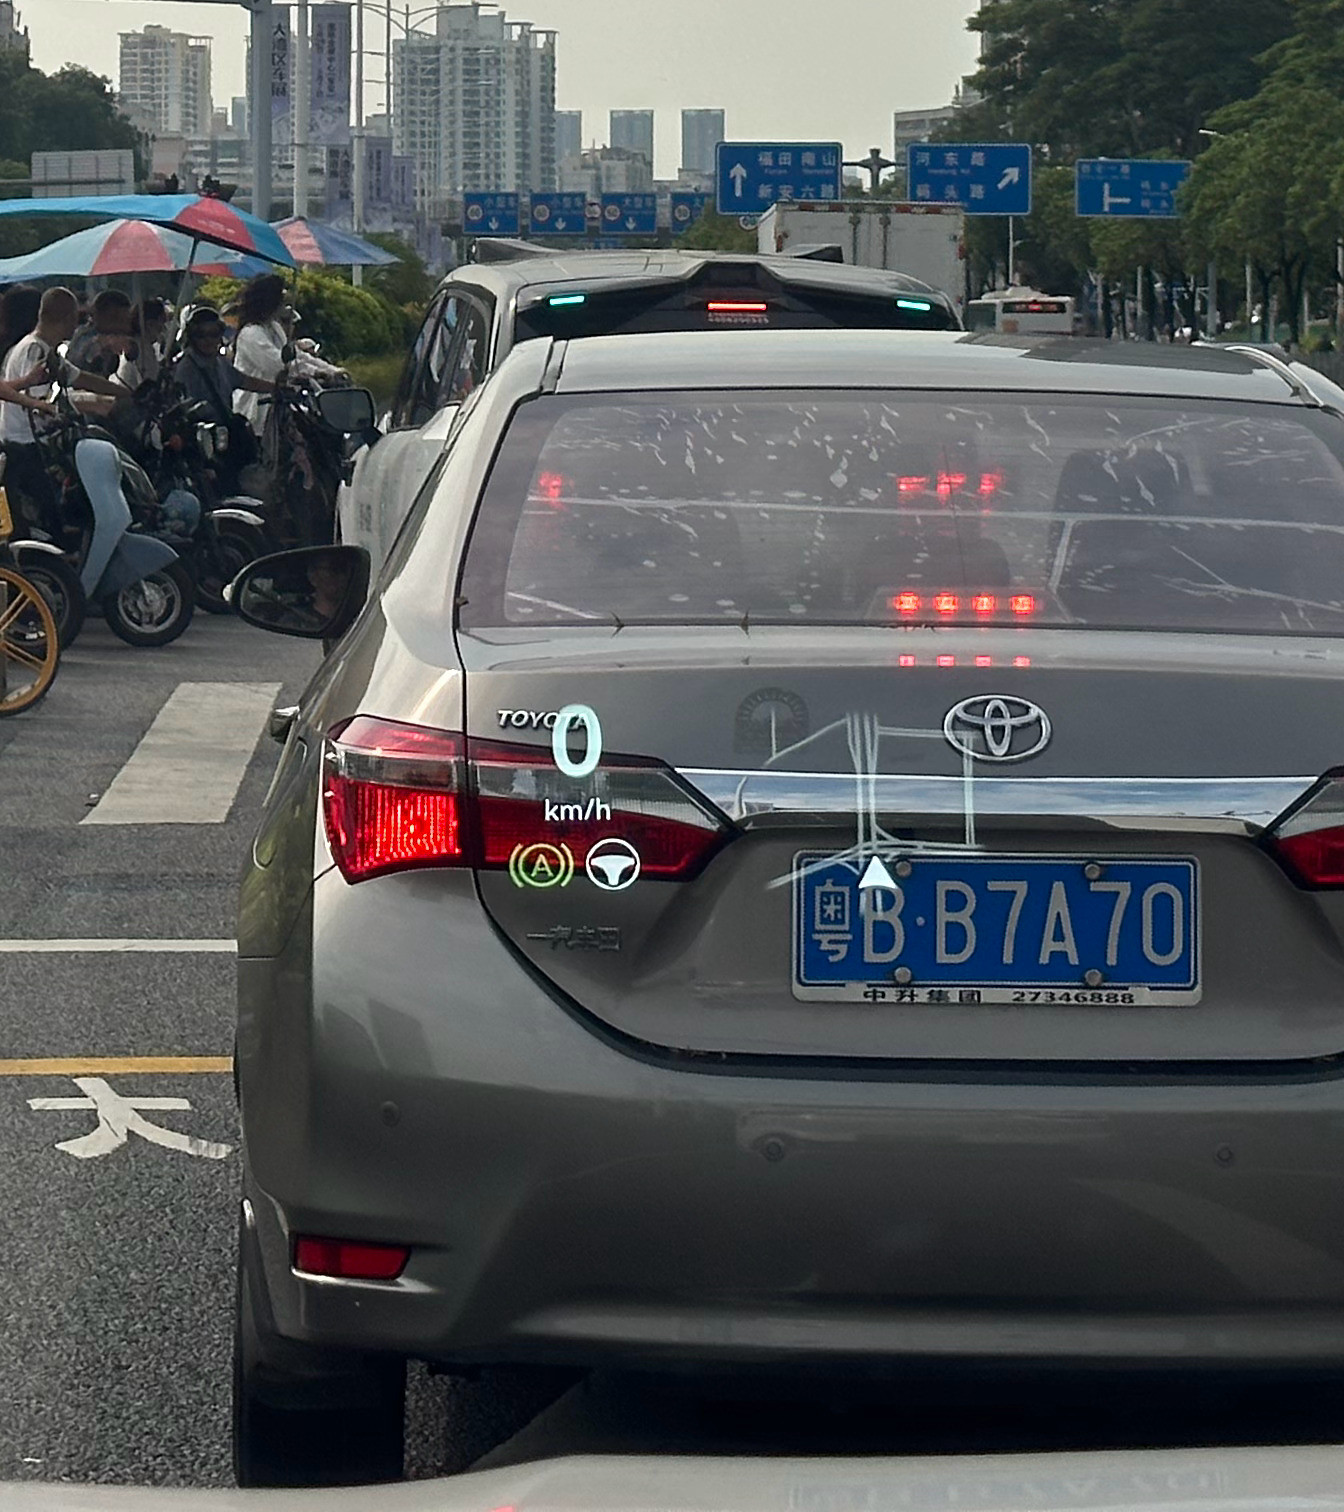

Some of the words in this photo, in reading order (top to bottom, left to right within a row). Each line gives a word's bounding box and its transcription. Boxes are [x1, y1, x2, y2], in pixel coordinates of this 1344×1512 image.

[758, 151, 792, 166] 福田
[801, 151, 836, 166] 南山
[758, 183, 835, 199] 新安六路
[497, 709, 589, 730] TOYOTA
[552, 704, 603, 778] 0
[544, 797, 611, 821] km/h
[812, 879, 1184, 967] 粤B·B7A70
[526, 925, 620, 950] 一汽丰田
[862, 989, 982, 1004] 中升集团
[1012, 990, 1135, 1004] 27346888
